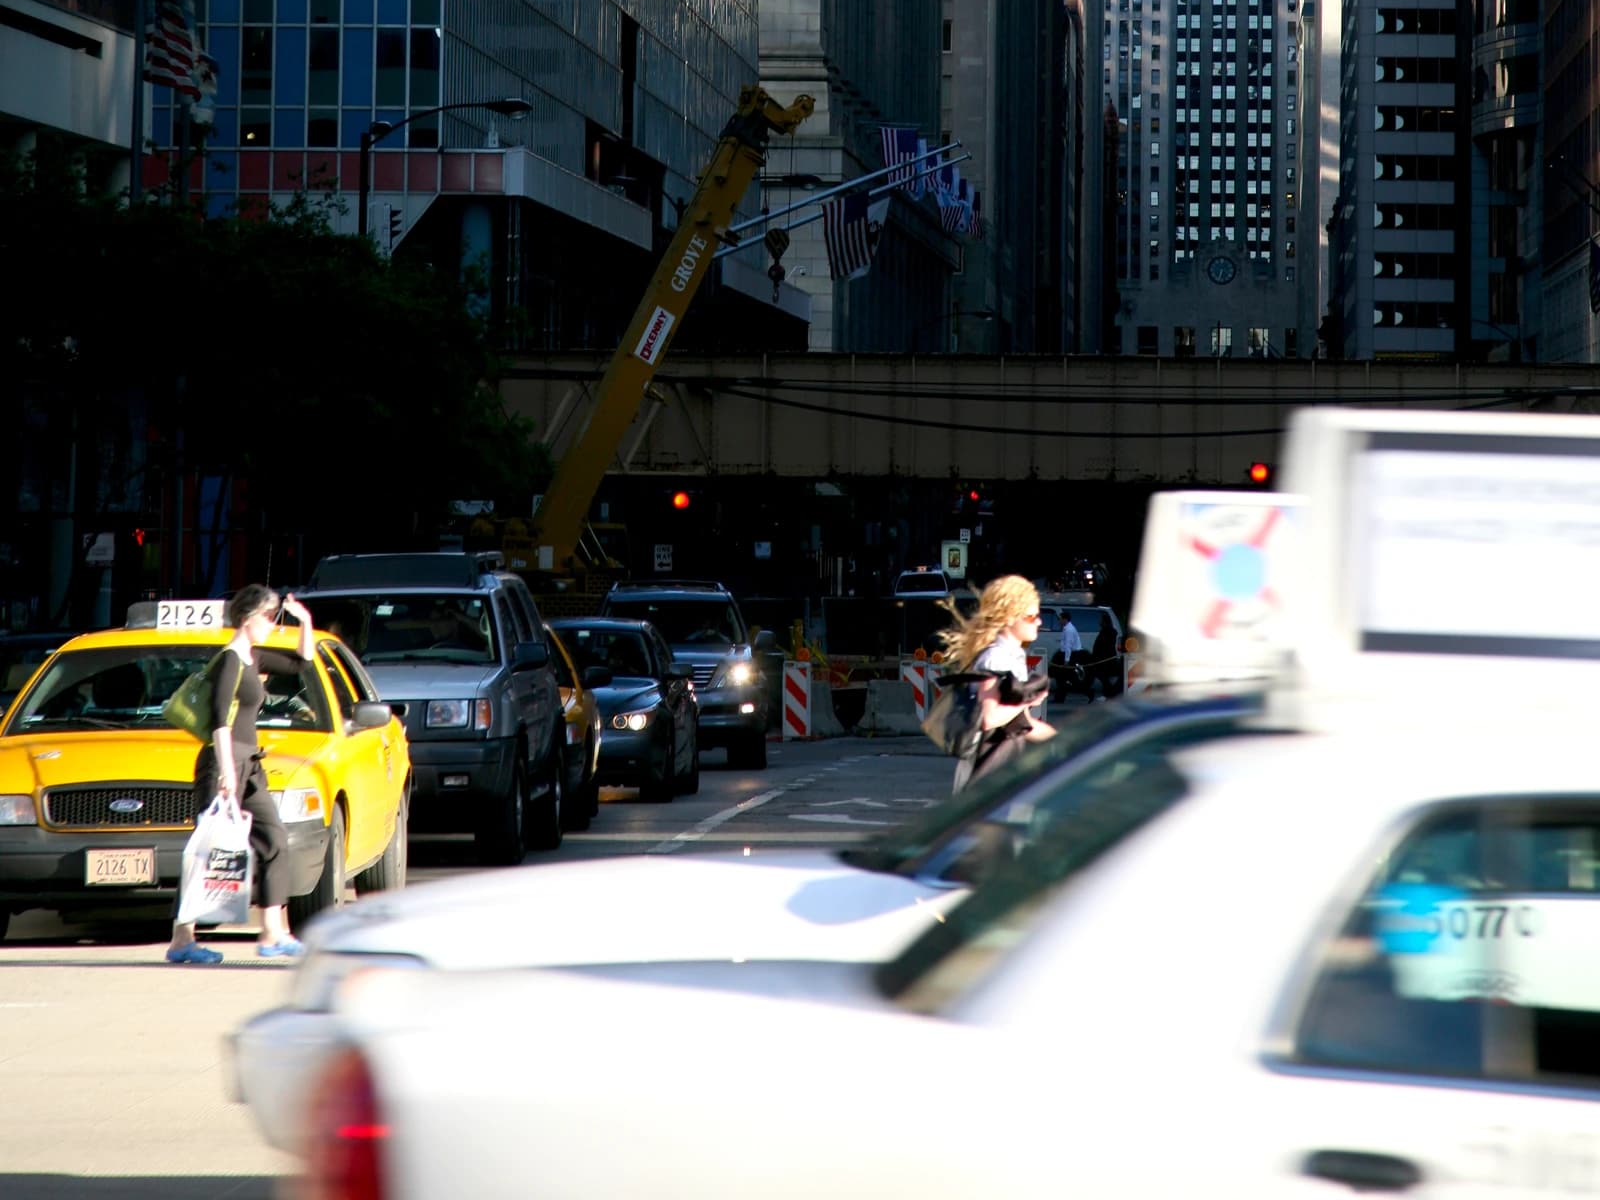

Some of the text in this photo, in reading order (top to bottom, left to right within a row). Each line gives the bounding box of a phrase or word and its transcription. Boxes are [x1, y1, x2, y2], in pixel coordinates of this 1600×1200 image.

[671, 233, 708, 292] GROVE
[645, 310, 667, 350] KENNY
[656, 553, 671, 561] WAY
[160, 605, 213, 625] 2126
[96, 858, 149, 875] 2126 TX
